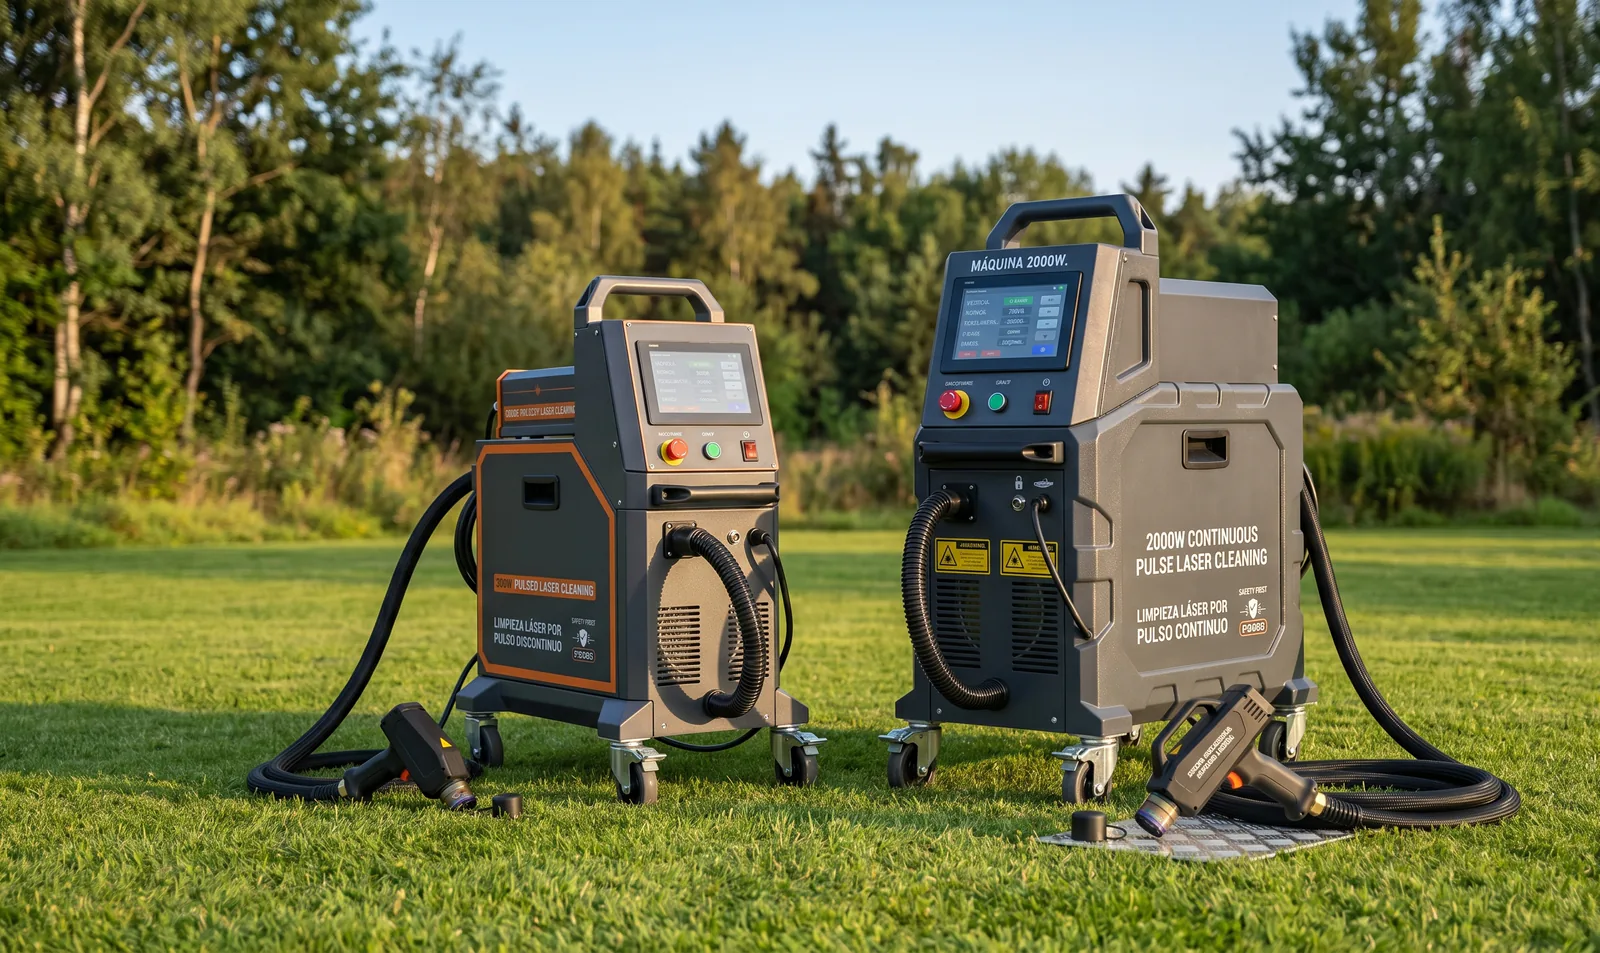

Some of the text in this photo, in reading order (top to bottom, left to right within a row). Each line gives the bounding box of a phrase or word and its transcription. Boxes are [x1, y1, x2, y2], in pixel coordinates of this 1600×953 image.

[970, 254, 1068, 272] MÁQUINA 2000W.
[1146, 525, 1259, 551] 2000W CONTINUOUS
[1136, 548, 1268, 576] PULSE LASER CLEANING
[514, 579, 538, 592] PULSED
[539, 581, 560, 593] LASER
[560, 583, 594, 597] CLEANING
[1136, 599, 1228, 623] LIMPIEZA LÁSER POR
[493, 617, 562, 636] LIMPIEZA LÁSER POR
[1137, 617, 1229, 645] PULSO CONTINUO
[493, 632, 563, 653] PULSO DISCONTINUO
